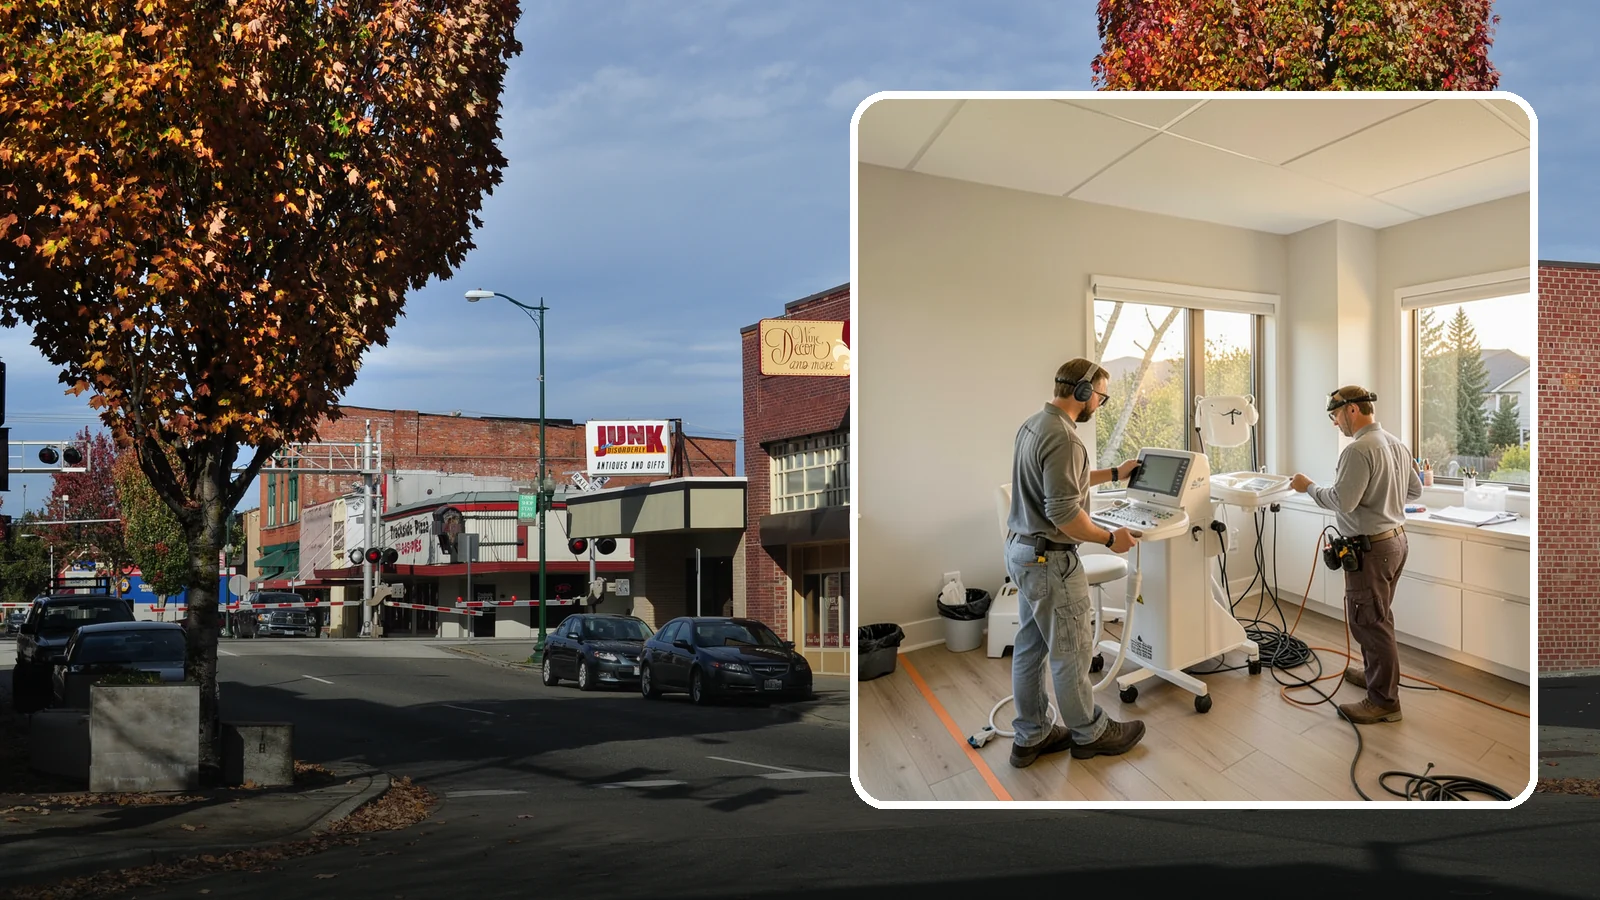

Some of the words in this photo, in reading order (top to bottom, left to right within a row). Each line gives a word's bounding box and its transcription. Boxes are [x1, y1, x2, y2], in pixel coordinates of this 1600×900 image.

[765, 328, 830, 365] Decor
[596, 425, 665, 457] JUNK
[607, 446, 646, 454] DISORDERLY
[596, 461, 628, 470] ANTIQUES
[631, 460, 644, 470] AND
[647, 460, 665, 469] GIFTS
[573, 473, 590, 492] RAIL
[414, 519, 429, 535] Pizza
